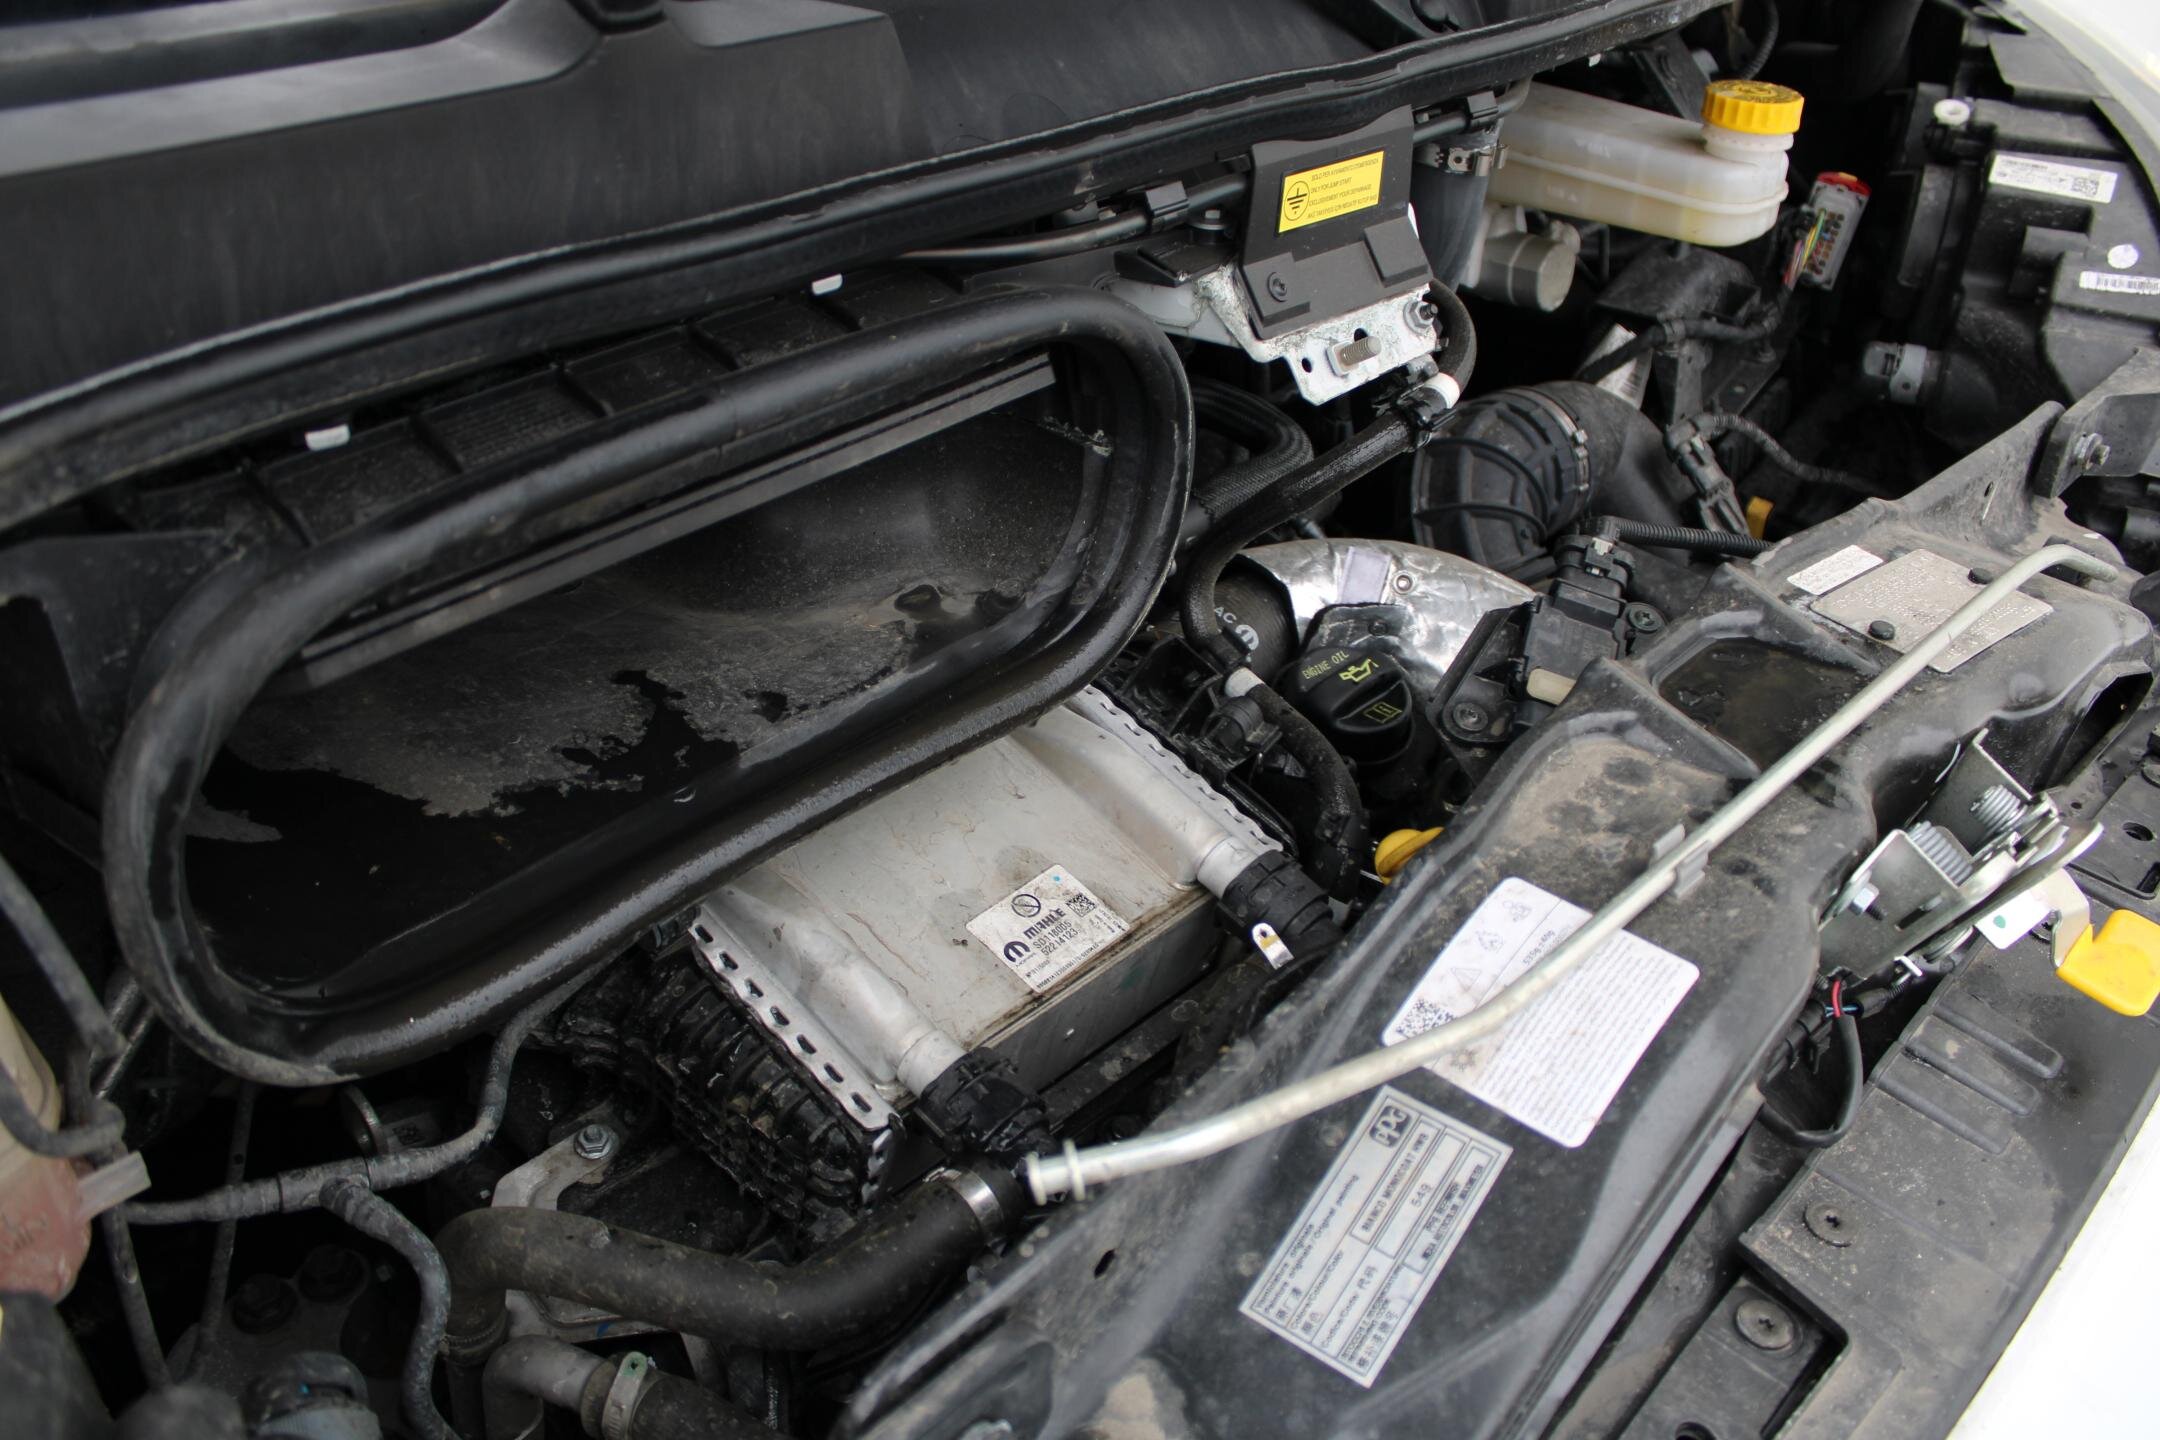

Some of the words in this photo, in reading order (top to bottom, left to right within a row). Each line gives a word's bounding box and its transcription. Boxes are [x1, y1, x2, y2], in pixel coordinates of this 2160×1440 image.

[1302, 660, 1331, 680] ENGINE
[1331, 650, 1349, 664] OIL
[1023, 907, 1066, 940] MAHLE
[1371, 1103, 1412, 1147] PPG
[1411, 1182, 1432, 1208] 549
[1314, 1208, 1338, 1239] Original
